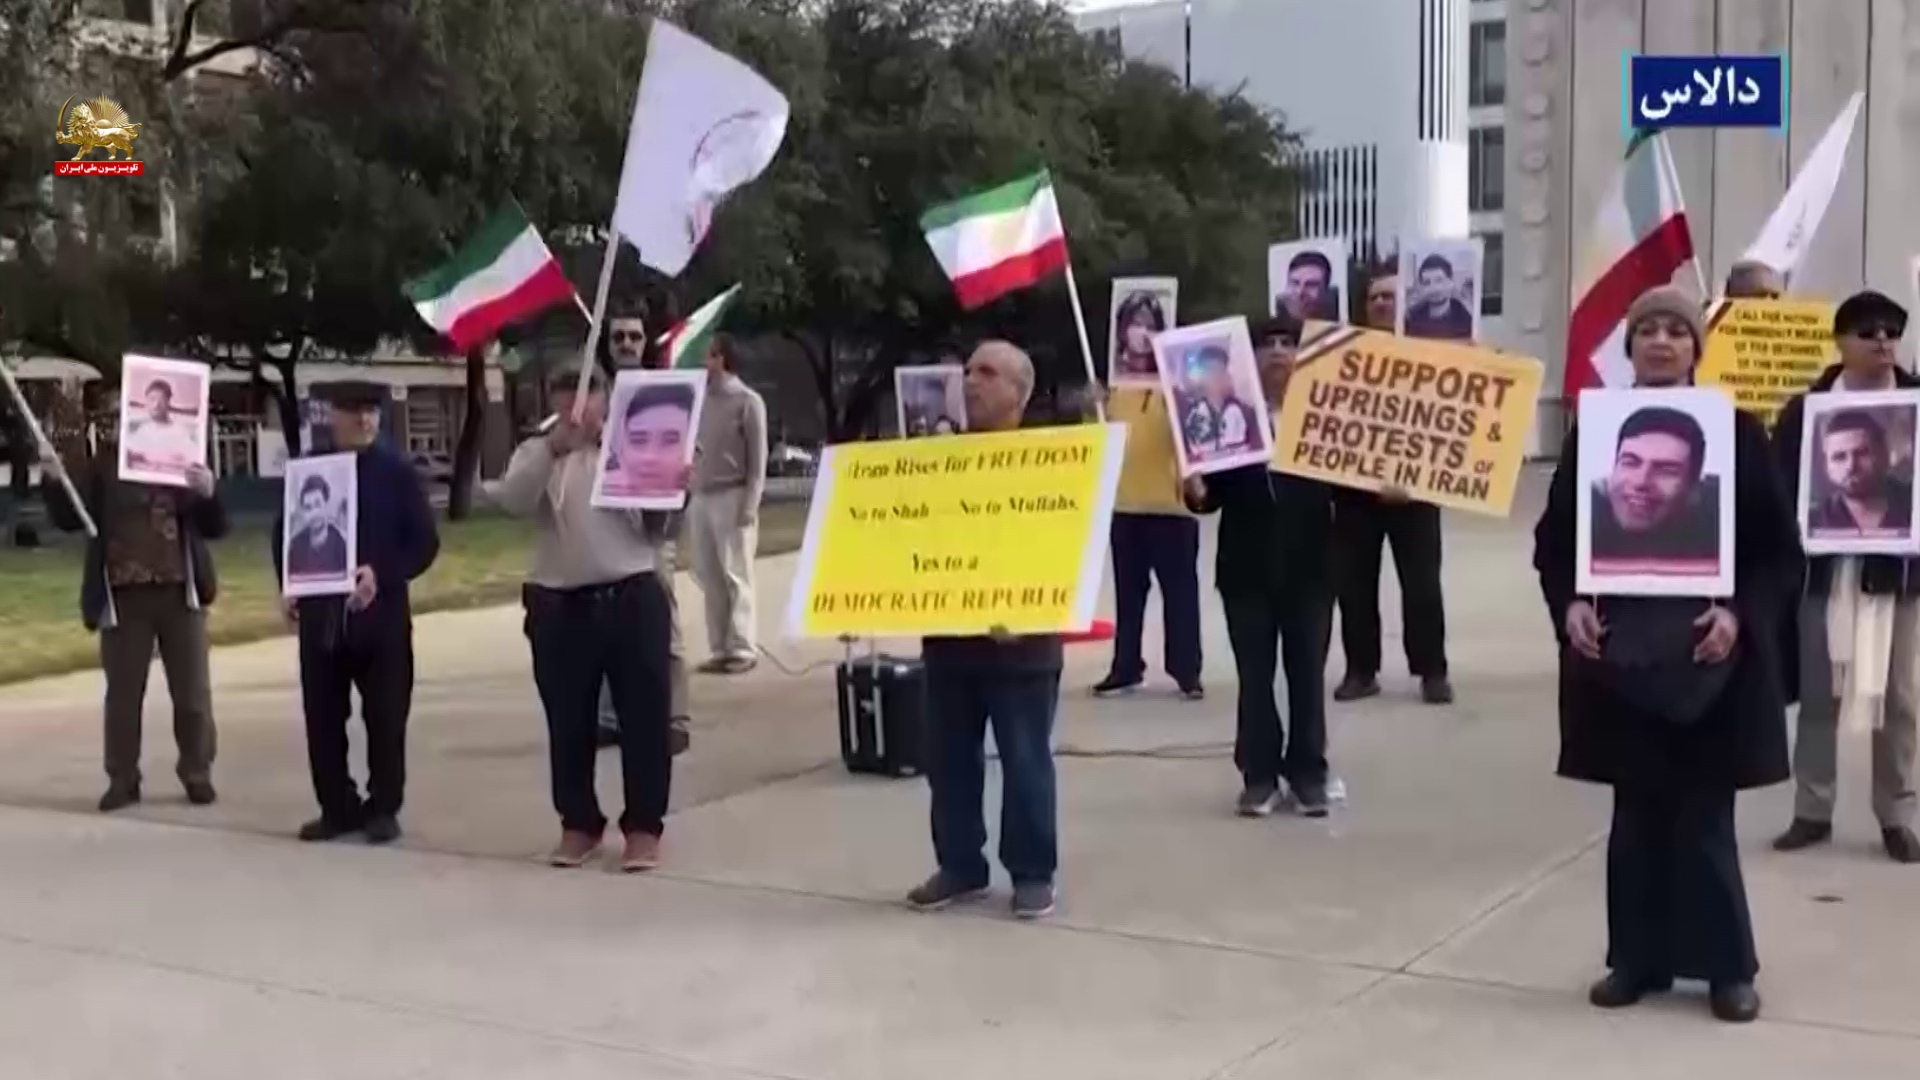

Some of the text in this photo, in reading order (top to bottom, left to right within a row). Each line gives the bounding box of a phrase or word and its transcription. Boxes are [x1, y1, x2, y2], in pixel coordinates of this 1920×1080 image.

[1338, 351, 1515, 410] SUPPORT
[1308, 380, 1502, 442] UPRISINGS &
[1300, 412, 1468, 470] PROTESTS
[895, 455, 939, 476] Rises
[944, 453, 972, 473] for
[1293, 441, 1489, 501] PEOPLE IN IRAN
[848, 506, 870, 521] No
[872, 506, 887, 520] to
[892, 502, 930, 519] Shah
[959, 499, 981, 515] No
[986, 499, 1001, 514] to
[912, 553, 979, 573] Yes to a
[813, 586, 1071, 613] DEMOCRATIC REPUBLIC
